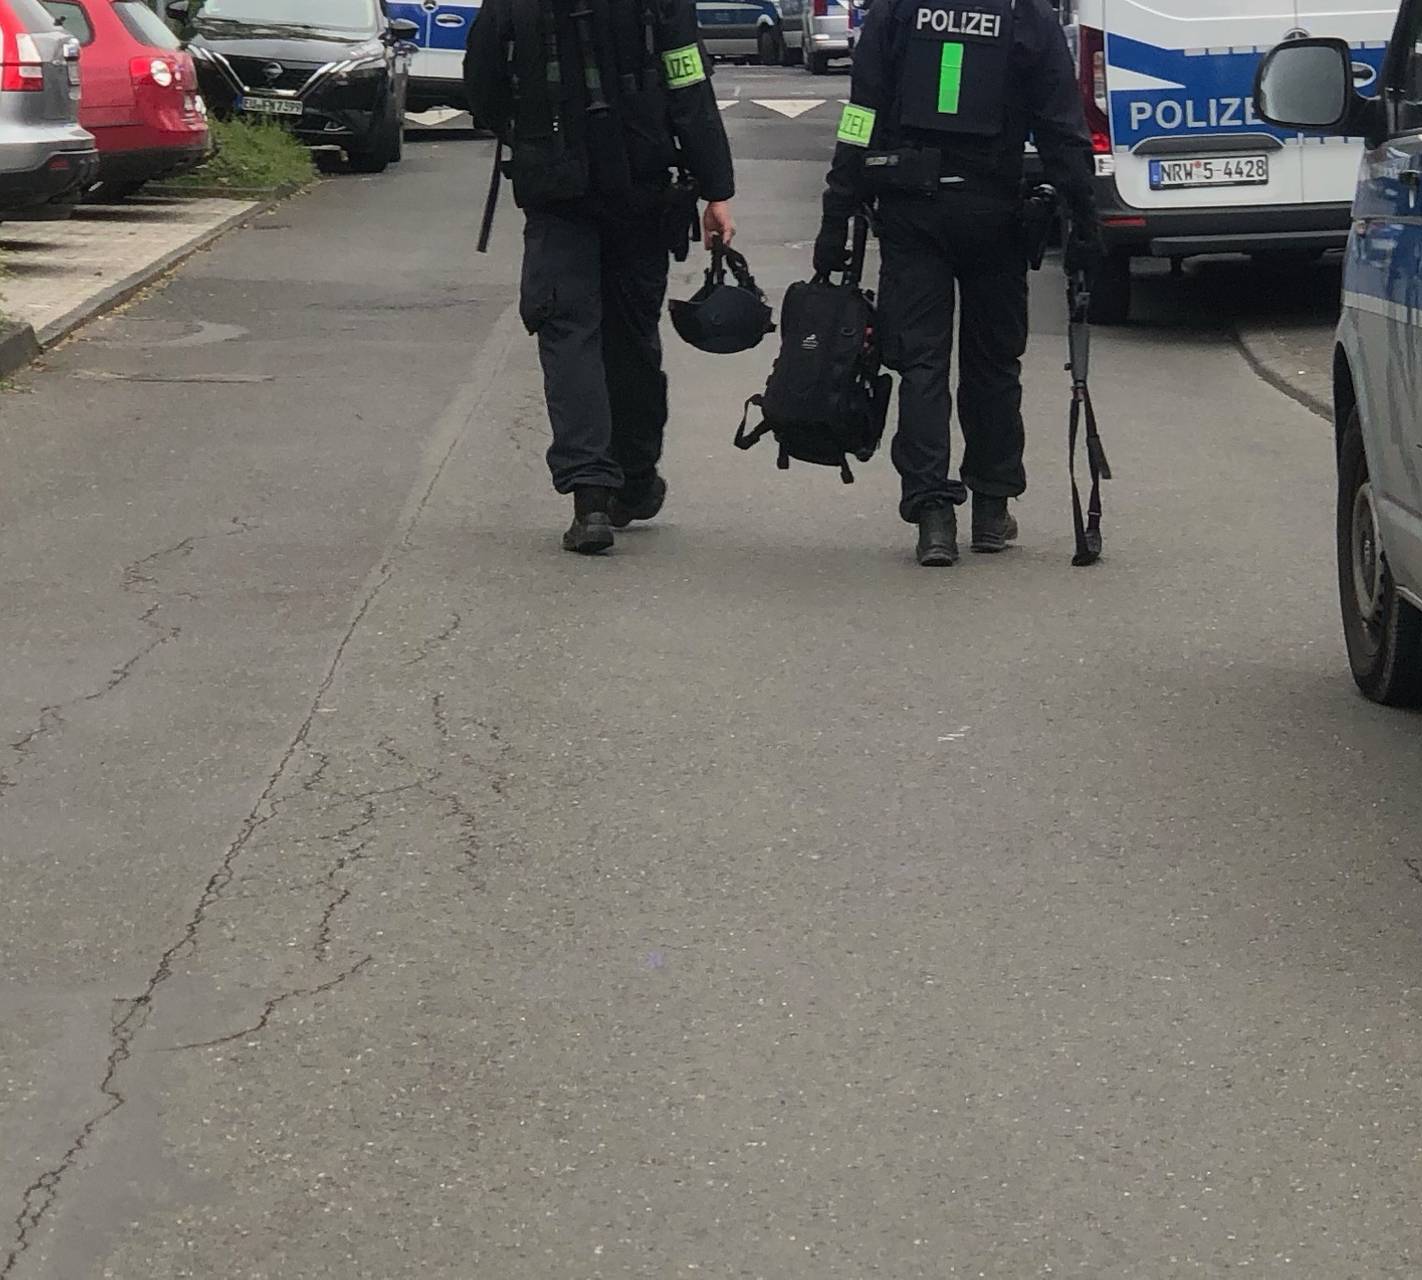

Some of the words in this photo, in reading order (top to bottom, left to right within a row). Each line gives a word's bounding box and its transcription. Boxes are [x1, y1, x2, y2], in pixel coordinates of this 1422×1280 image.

[916, 8, 1001, 37] POLIZEI
[1161, 163, 1194, 182] NRW
[1203, 159, 1266, 180] 5-4428
